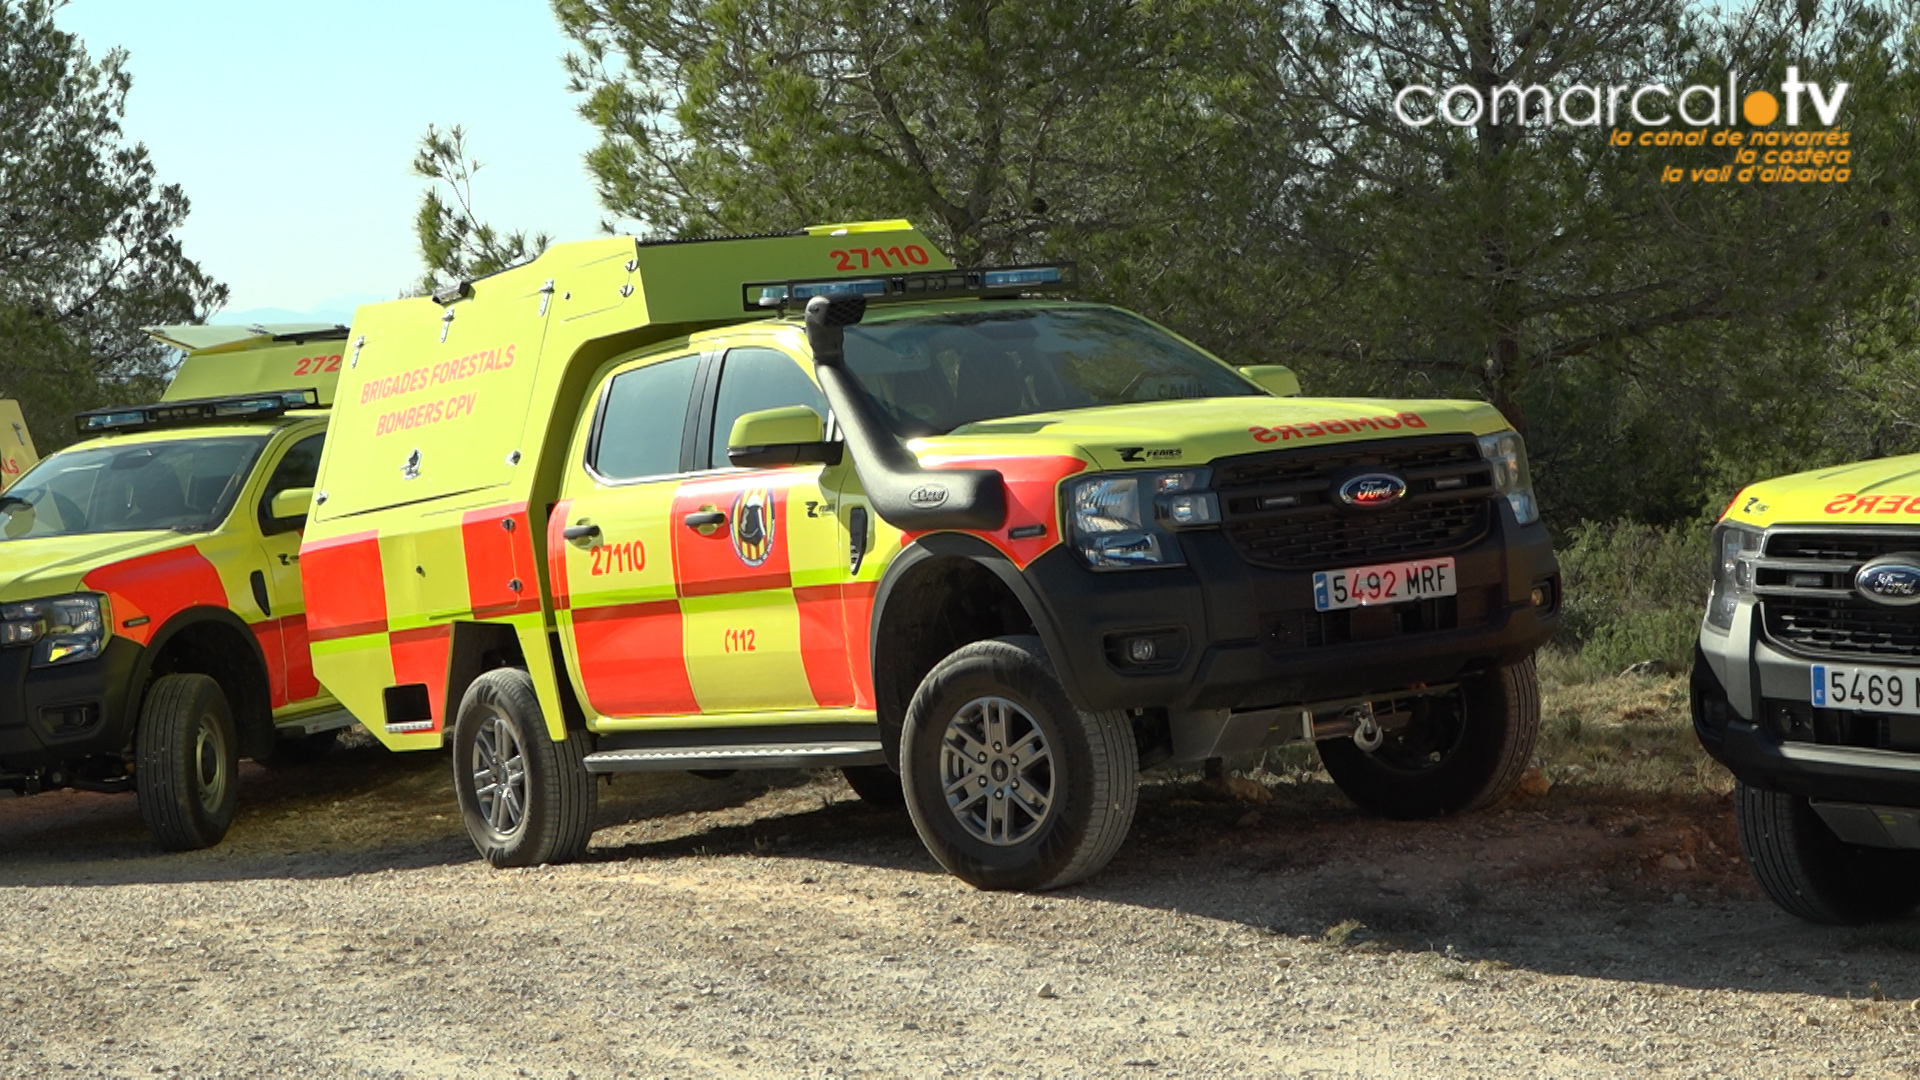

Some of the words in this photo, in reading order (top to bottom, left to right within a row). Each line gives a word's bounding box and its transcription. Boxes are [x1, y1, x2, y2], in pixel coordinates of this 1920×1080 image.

[829, 244, 930, 271] 27110
[360, 366, 429, 405] BRIGADES
[430, 344, 516, 387] FORESTALS
[375, 399, 444, 437] BOMBERS
[445, 391, 478, 421] CPV
[1357, 480, 1392, 500] Ford
[590, 539, 646, 577] 27110
[1333, 570, 1397, 604] 5492
[1406, 563, 1449, 596] MRF
[1874, 572, 1916, 596] Ford
[1831, 671, 1903, 707] 5469
